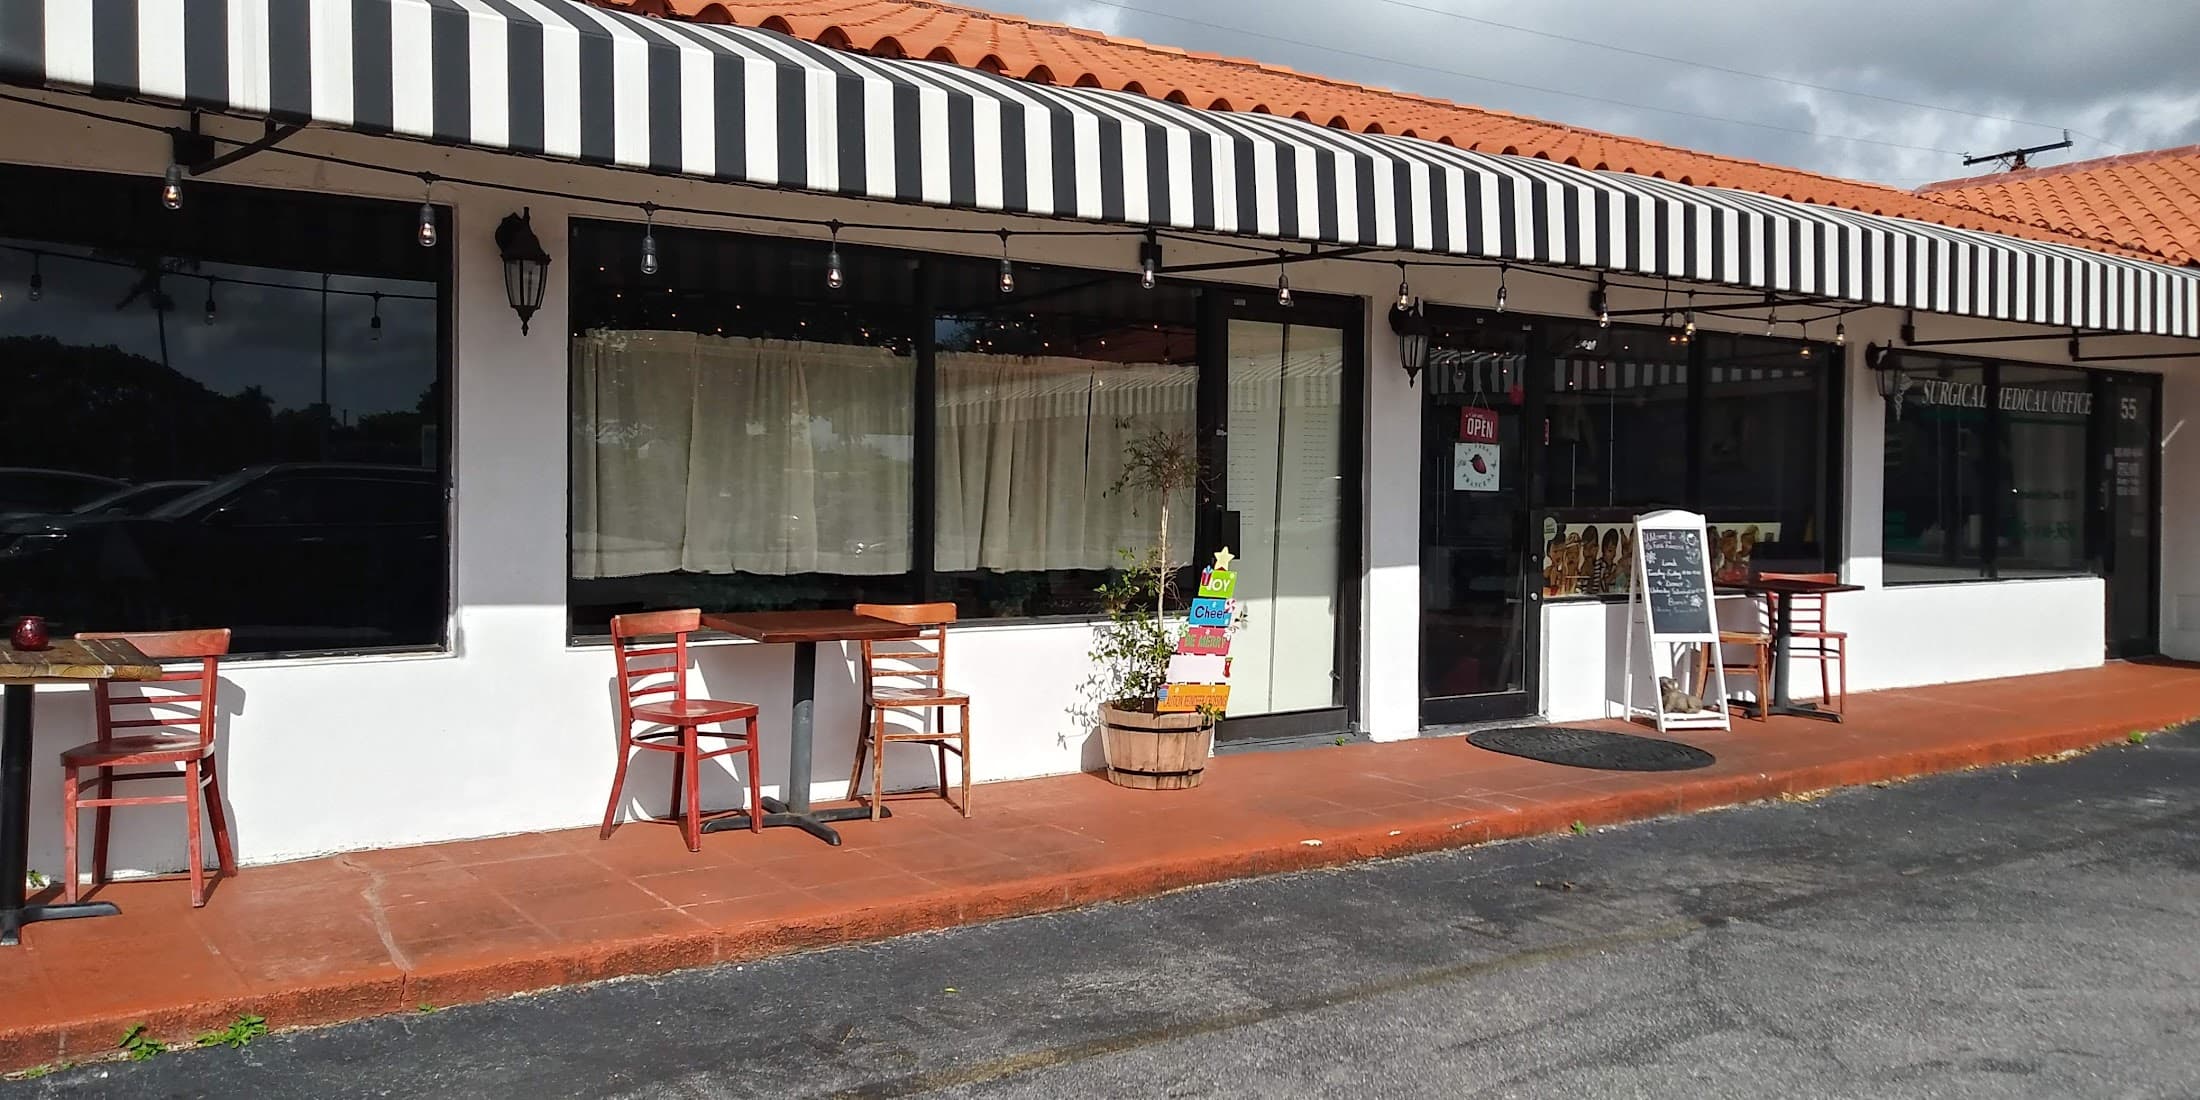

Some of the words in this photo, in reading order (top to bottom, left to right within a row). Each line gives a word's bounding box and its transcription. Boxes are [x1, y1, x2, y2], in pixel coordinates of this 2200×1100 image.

[1922, 379, 1988, 408] SURGICAL
[2051, 391, 2093, 415] OFFICE
[2120, 397, 2137, 420] 55
[1467, 417, 1494, 439] OPEN
[1206, 578, 1231, 592] JOY
[1194, 605, 1229, 619] Cheer
